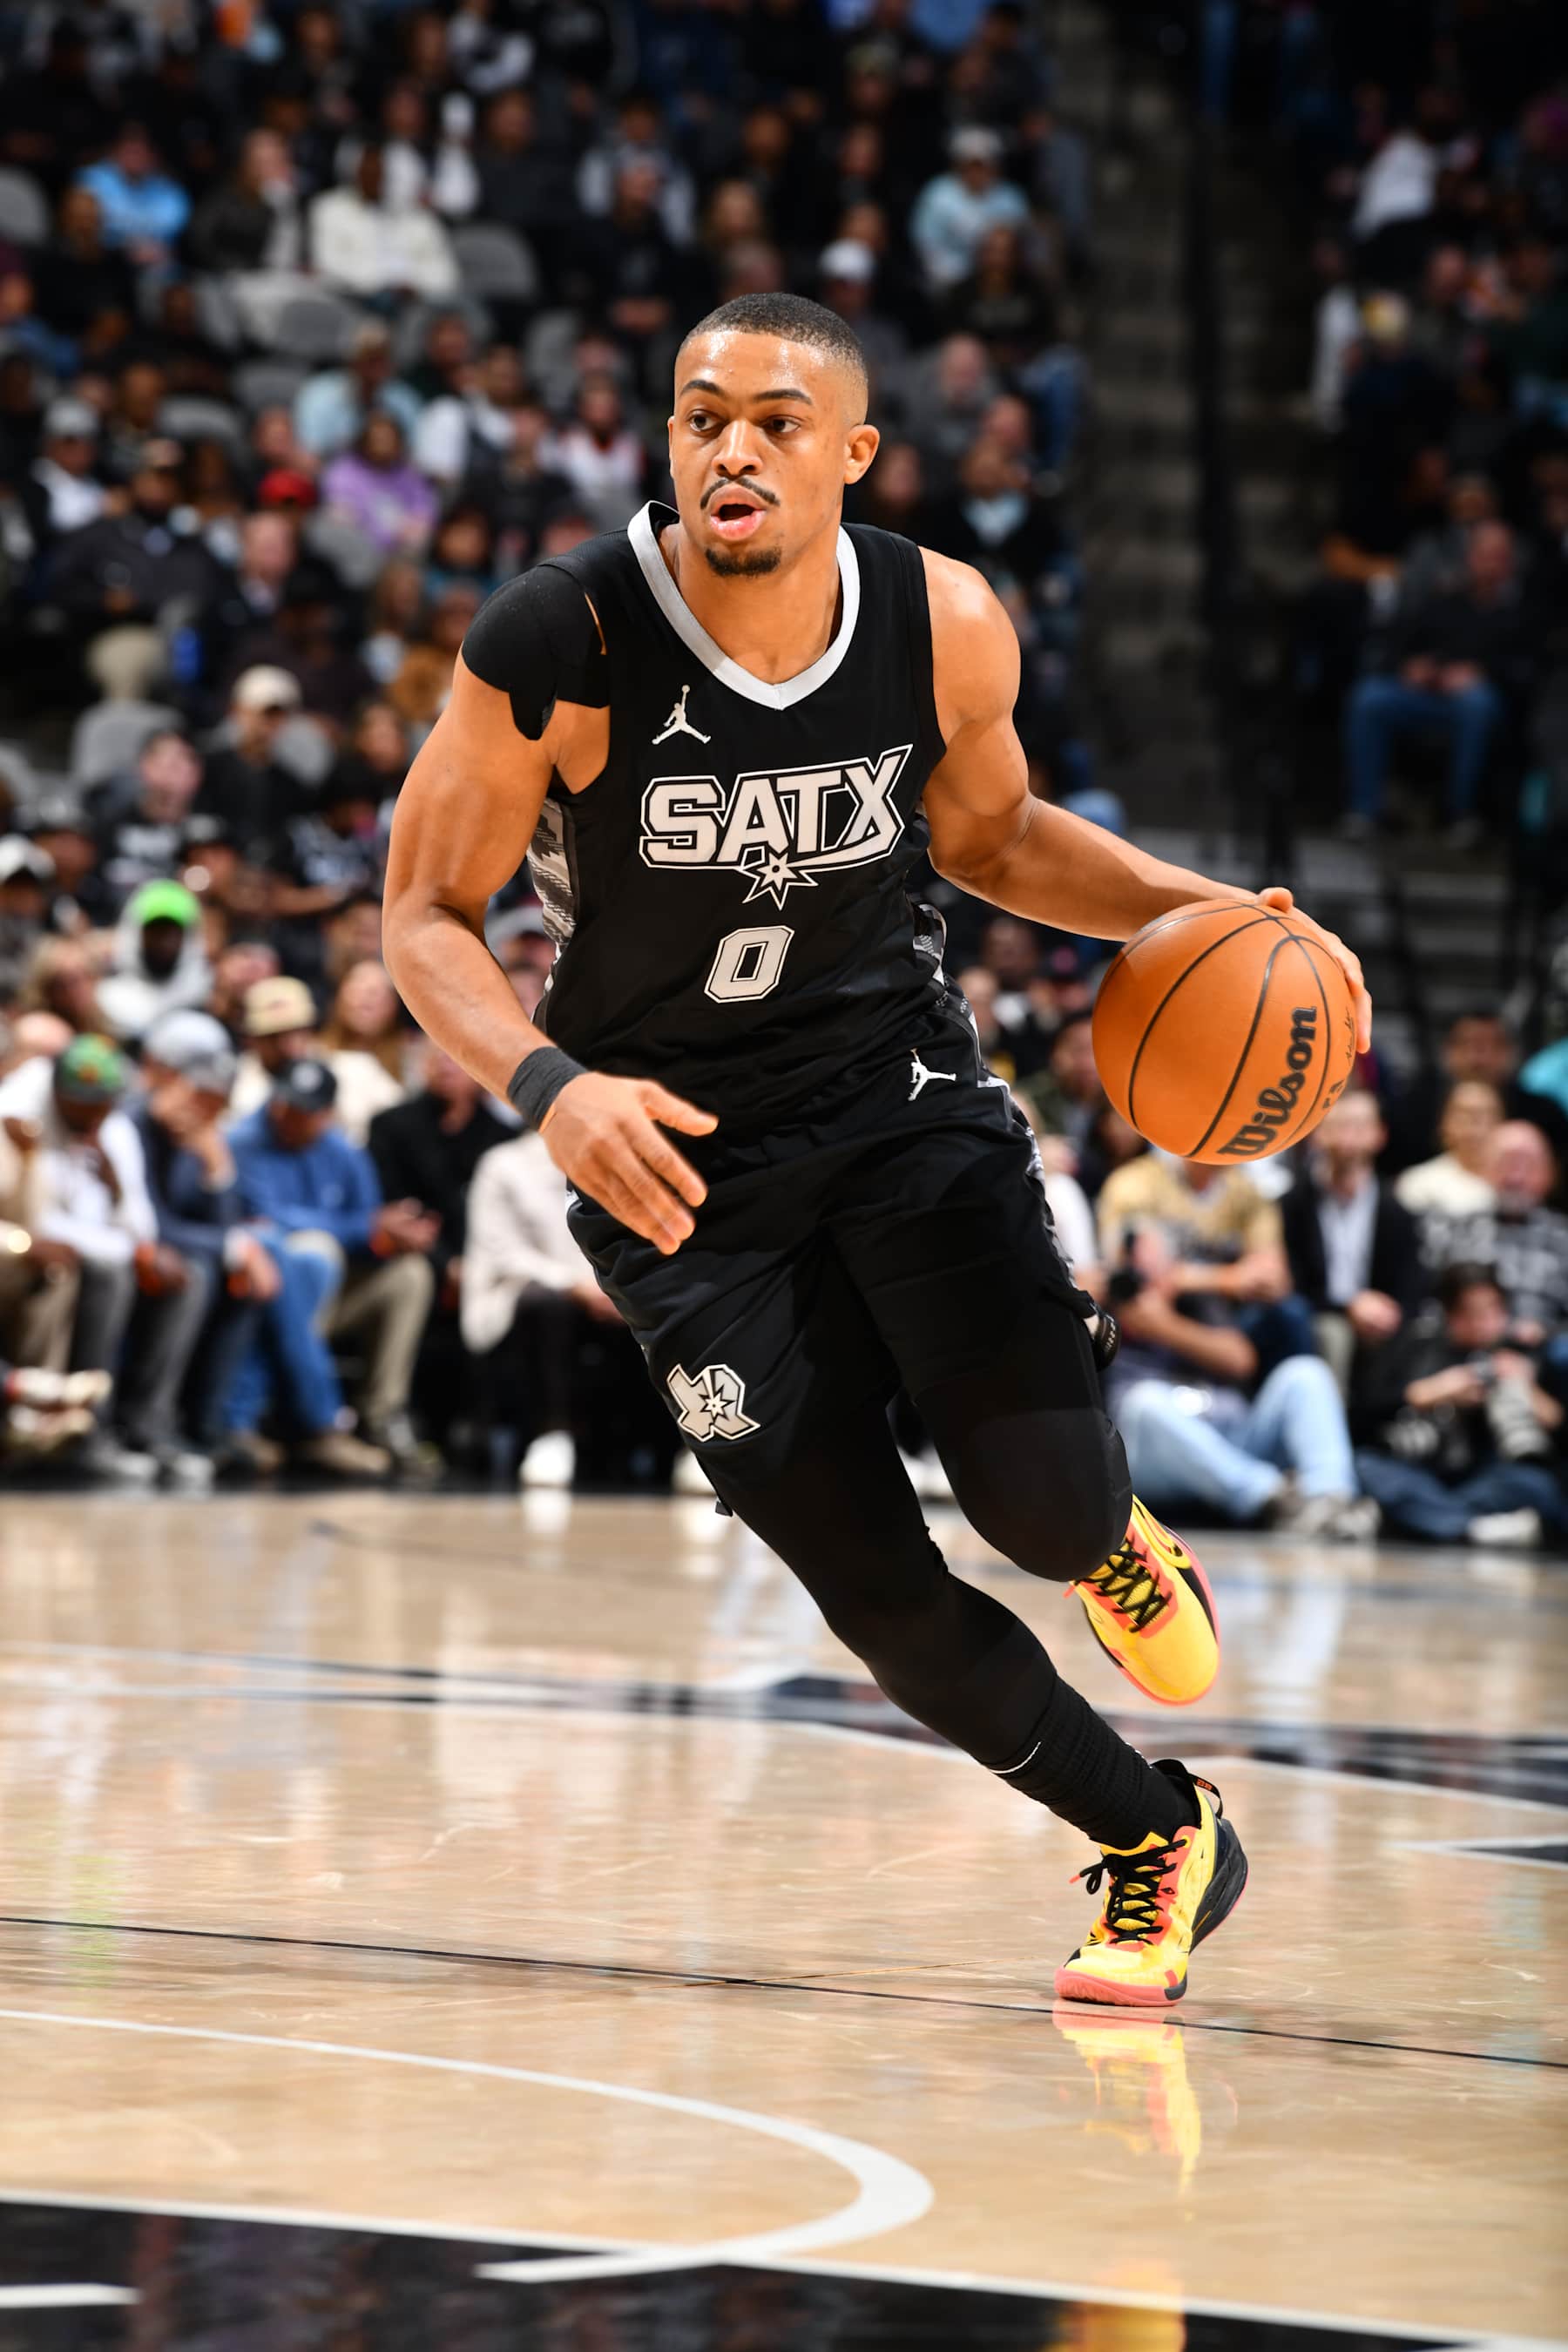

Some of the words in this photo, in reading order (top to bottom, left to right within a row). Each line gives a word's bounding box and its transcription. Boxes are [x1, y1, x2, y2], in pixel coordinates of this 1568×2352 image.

[639, 744, 913, 871] SATX
[704, 925, 794, 1003] 0
[1216, 1005, 1318, 1157] Wilson
